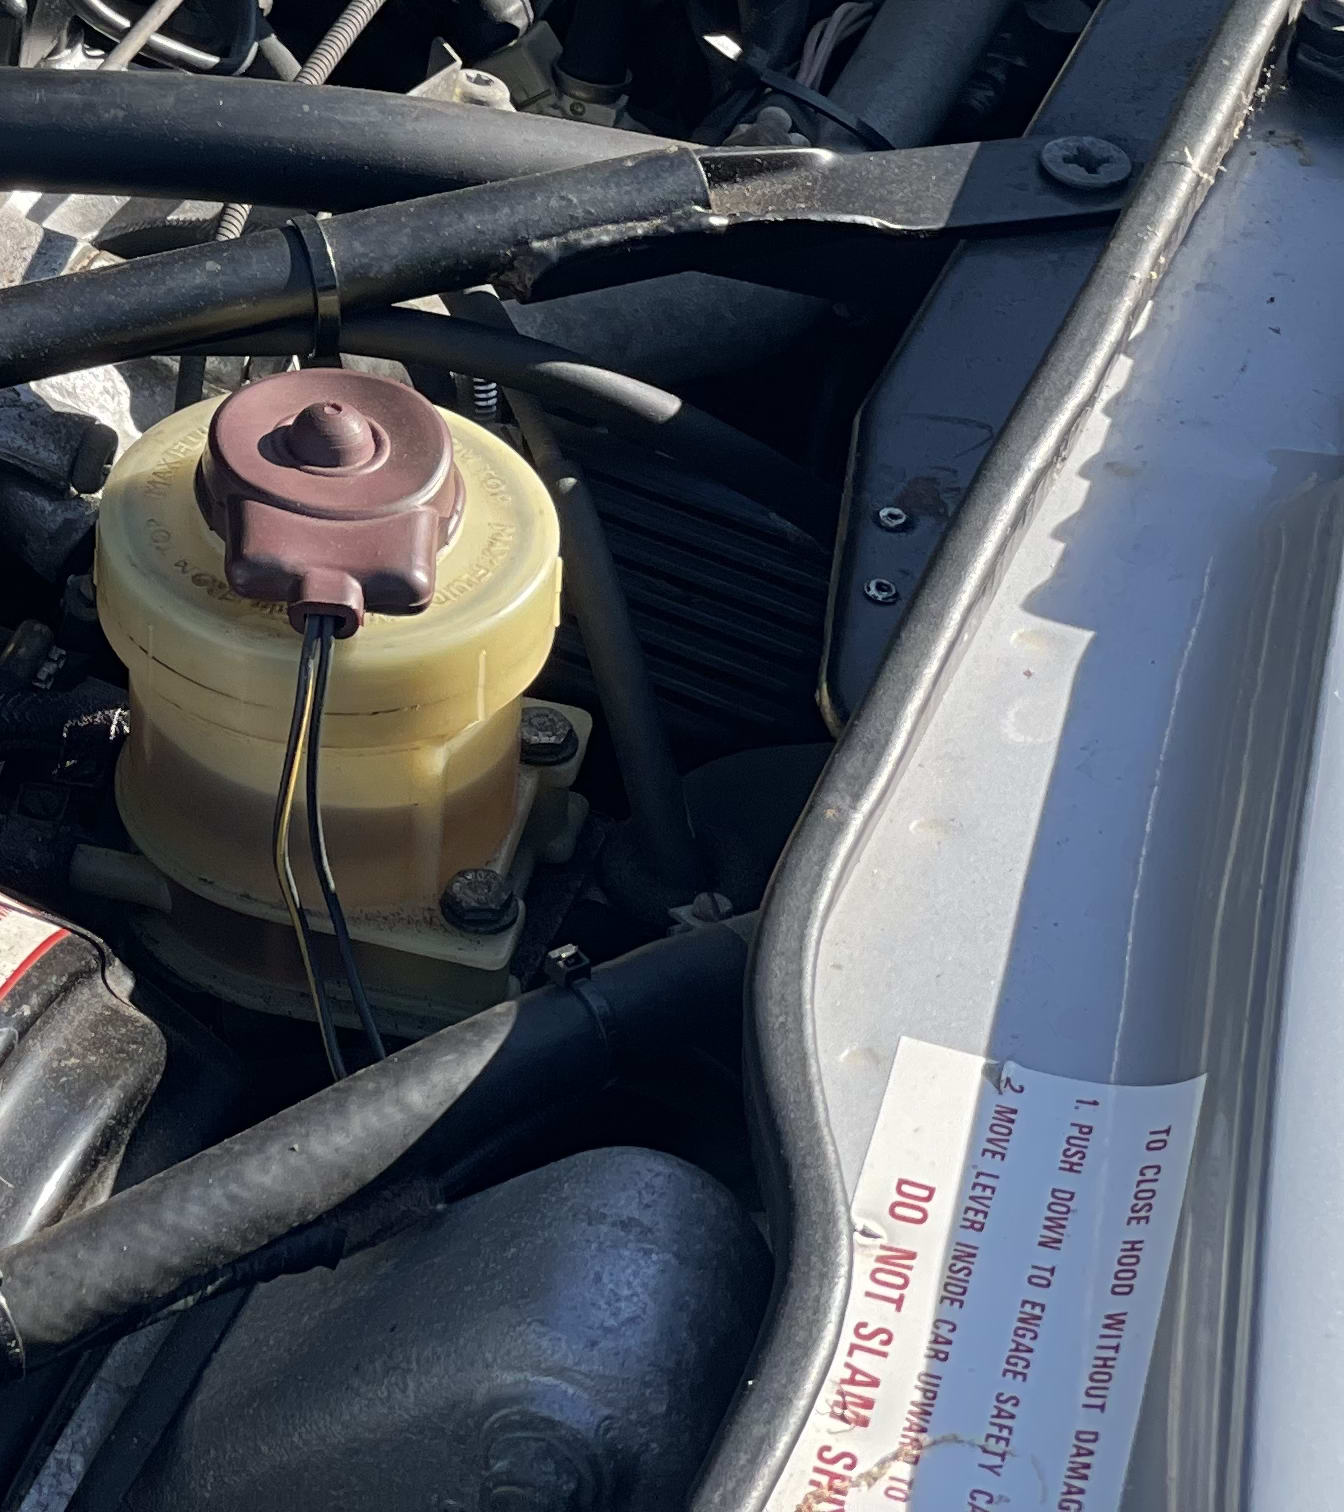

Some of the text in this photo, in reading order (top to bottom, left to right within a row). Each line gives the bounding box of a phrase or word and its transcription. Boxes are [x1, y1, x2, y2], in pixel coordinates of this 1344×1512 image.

[981, 1104, 1019, 1162] MOVE
[1074, 1098, 1099, 1111] 1.
[1058, 1122, 1094, 1175] PUSH
[1145, 1124, 1172, 1152] TO
[960, 1171, 1001, 1233] LEVER
[1037, 1188, 1076, 1251] DOWN
[1126, 1164, 1162, 1227] CLOSE
[939, 1241, 979, 1310] INSIDE
[1027, 1262, 1056, 1289] TO
[1110, 1239, 1145, 1296] HOOD
[828, 1177, 937, 1429] DO NOT SLAM
[924, 1316, 958, 1363] CAR
[1001, 1299, 1047, 1383] ENGAGE
[1081, 1311, 1129, 1414] WITHOUT
[977, 1392, 1021, 1478] SAFETY
[884, 1475, 914, 1503] TO
